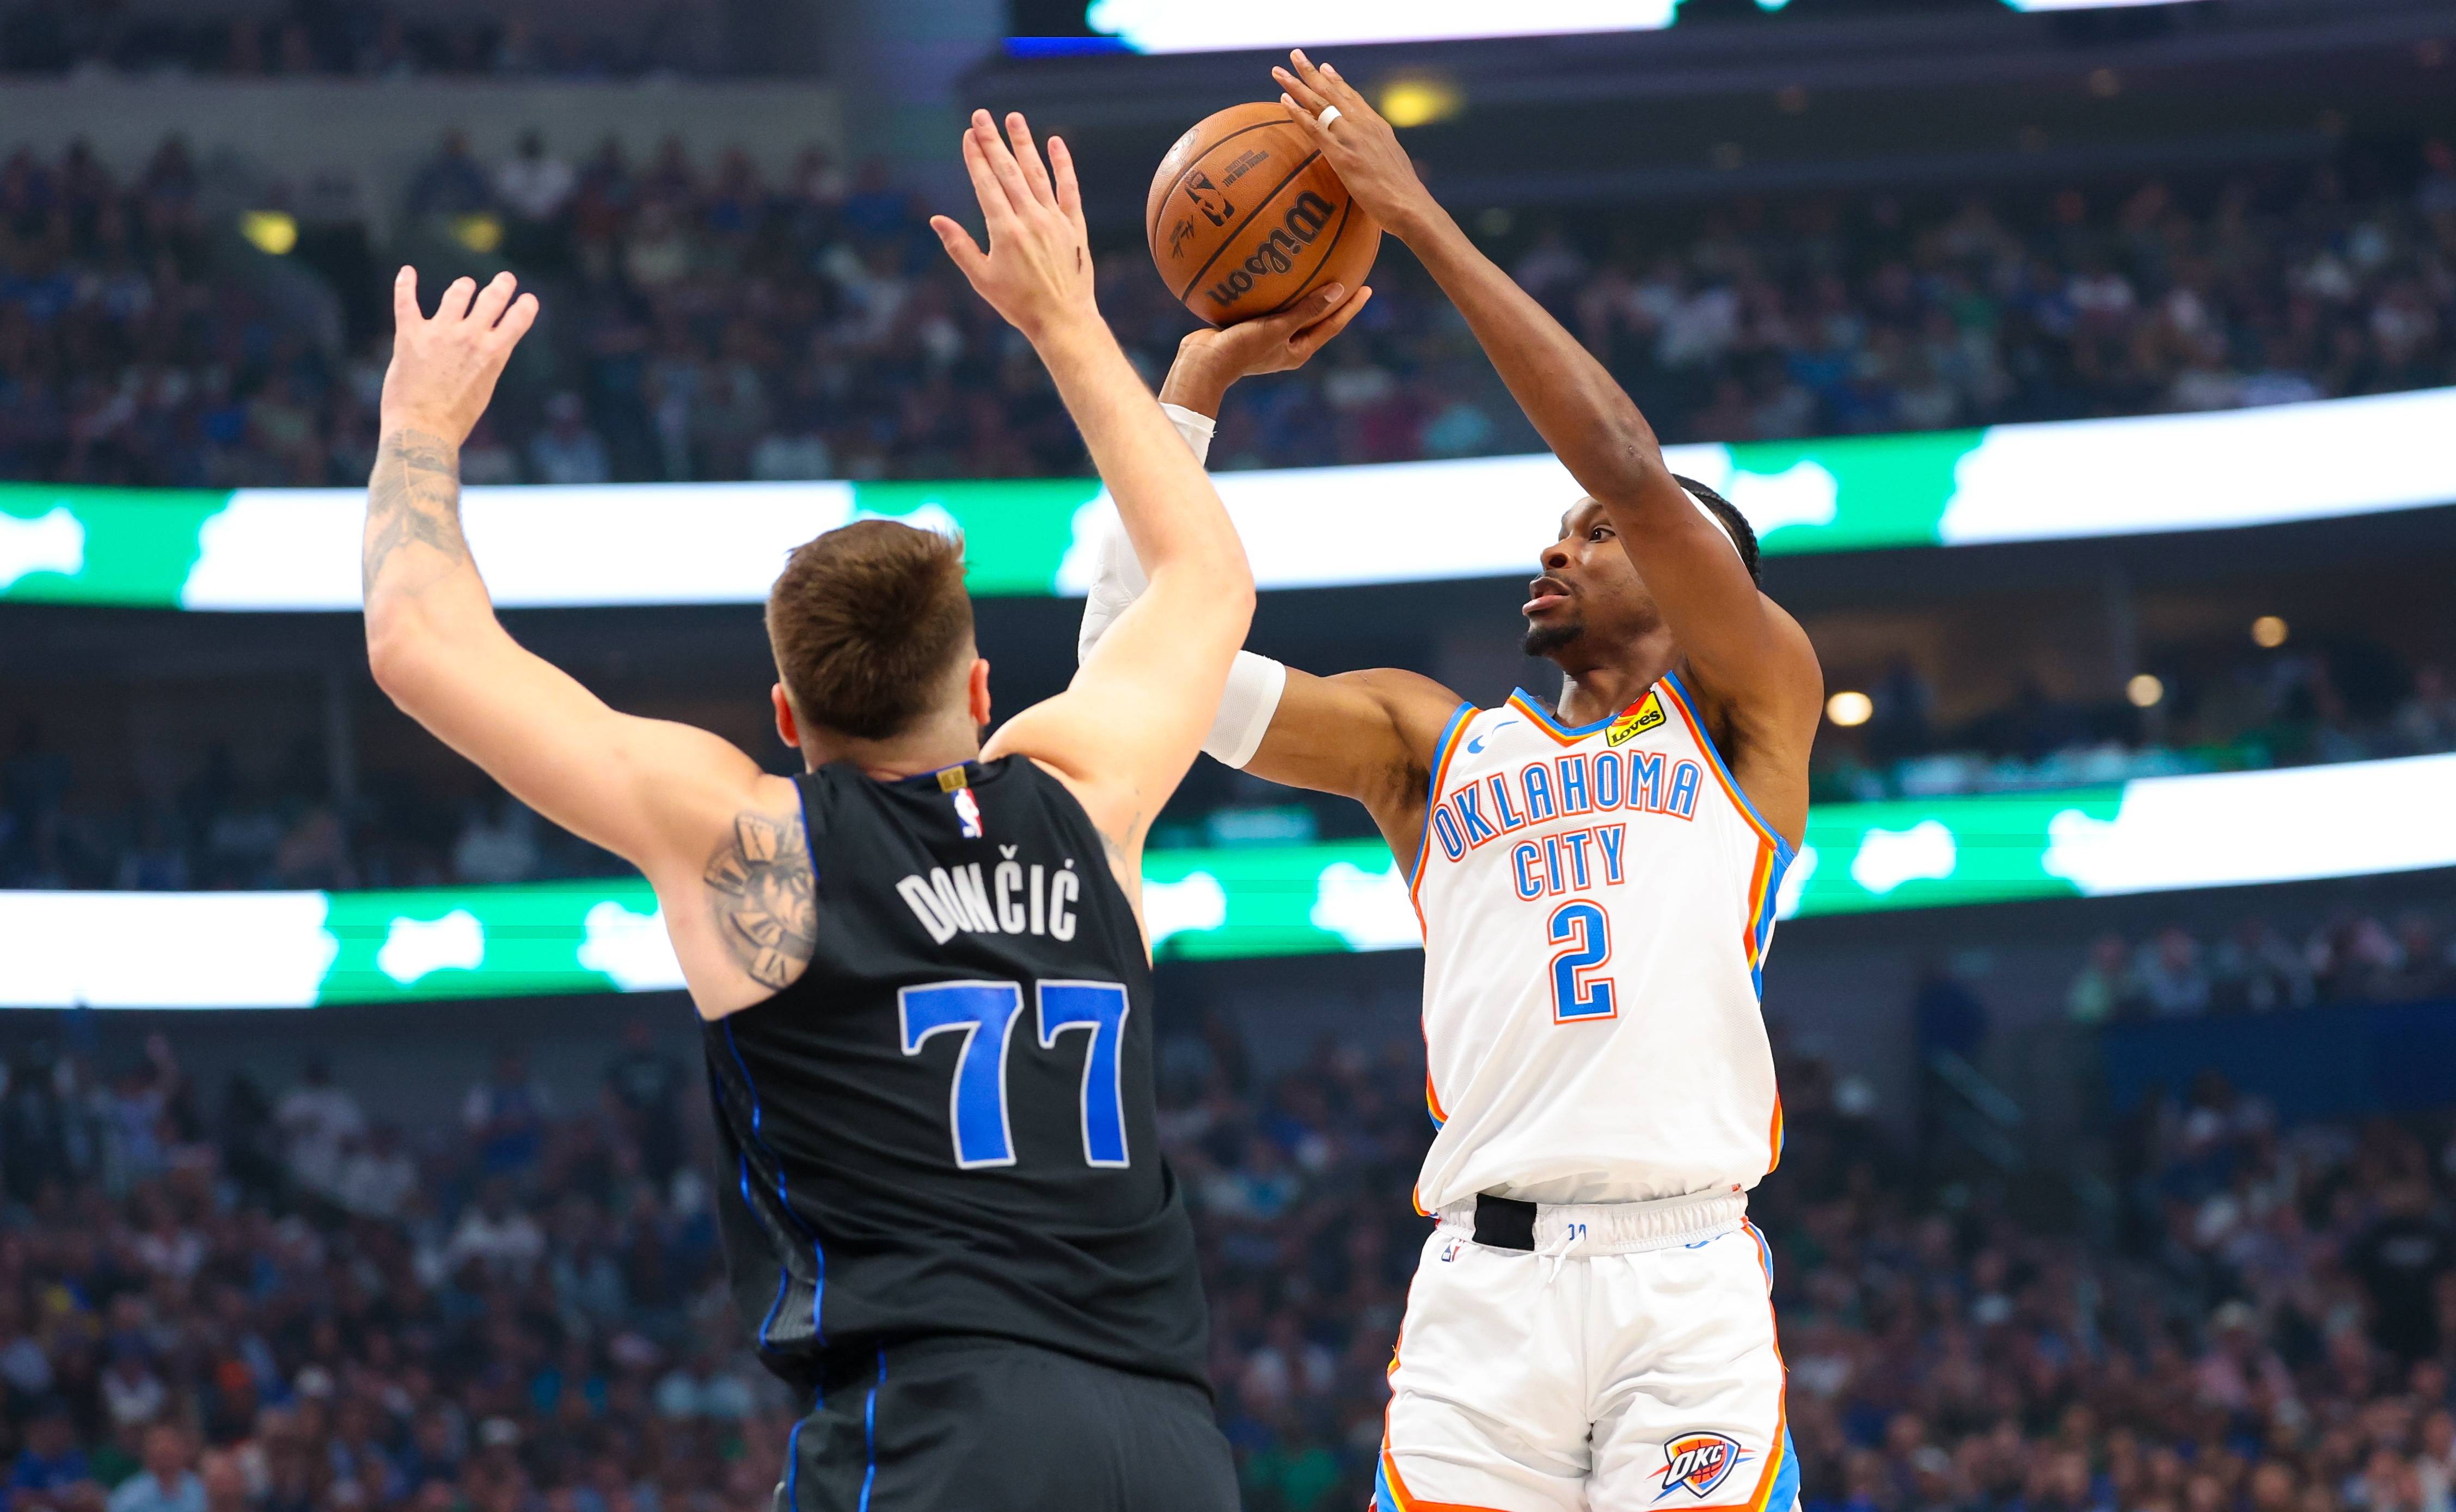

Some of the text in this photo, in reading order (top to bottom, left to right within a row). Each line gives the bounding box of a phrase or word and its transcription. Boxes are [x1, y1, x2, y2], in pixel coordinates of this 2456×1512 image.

[1205, 190, 1337, 308] Wilson
[1432, 749, 1702, 862] OKLAHOMA
[1511, 823, 1626, 901] CITY
[895, 844, 1080, 945] DONČIĆ
[1547, 898, 1618, 1025] 2
[897, 980, 1130, 1170] 77
[1662, 1444, 1725, 1490] OKC
